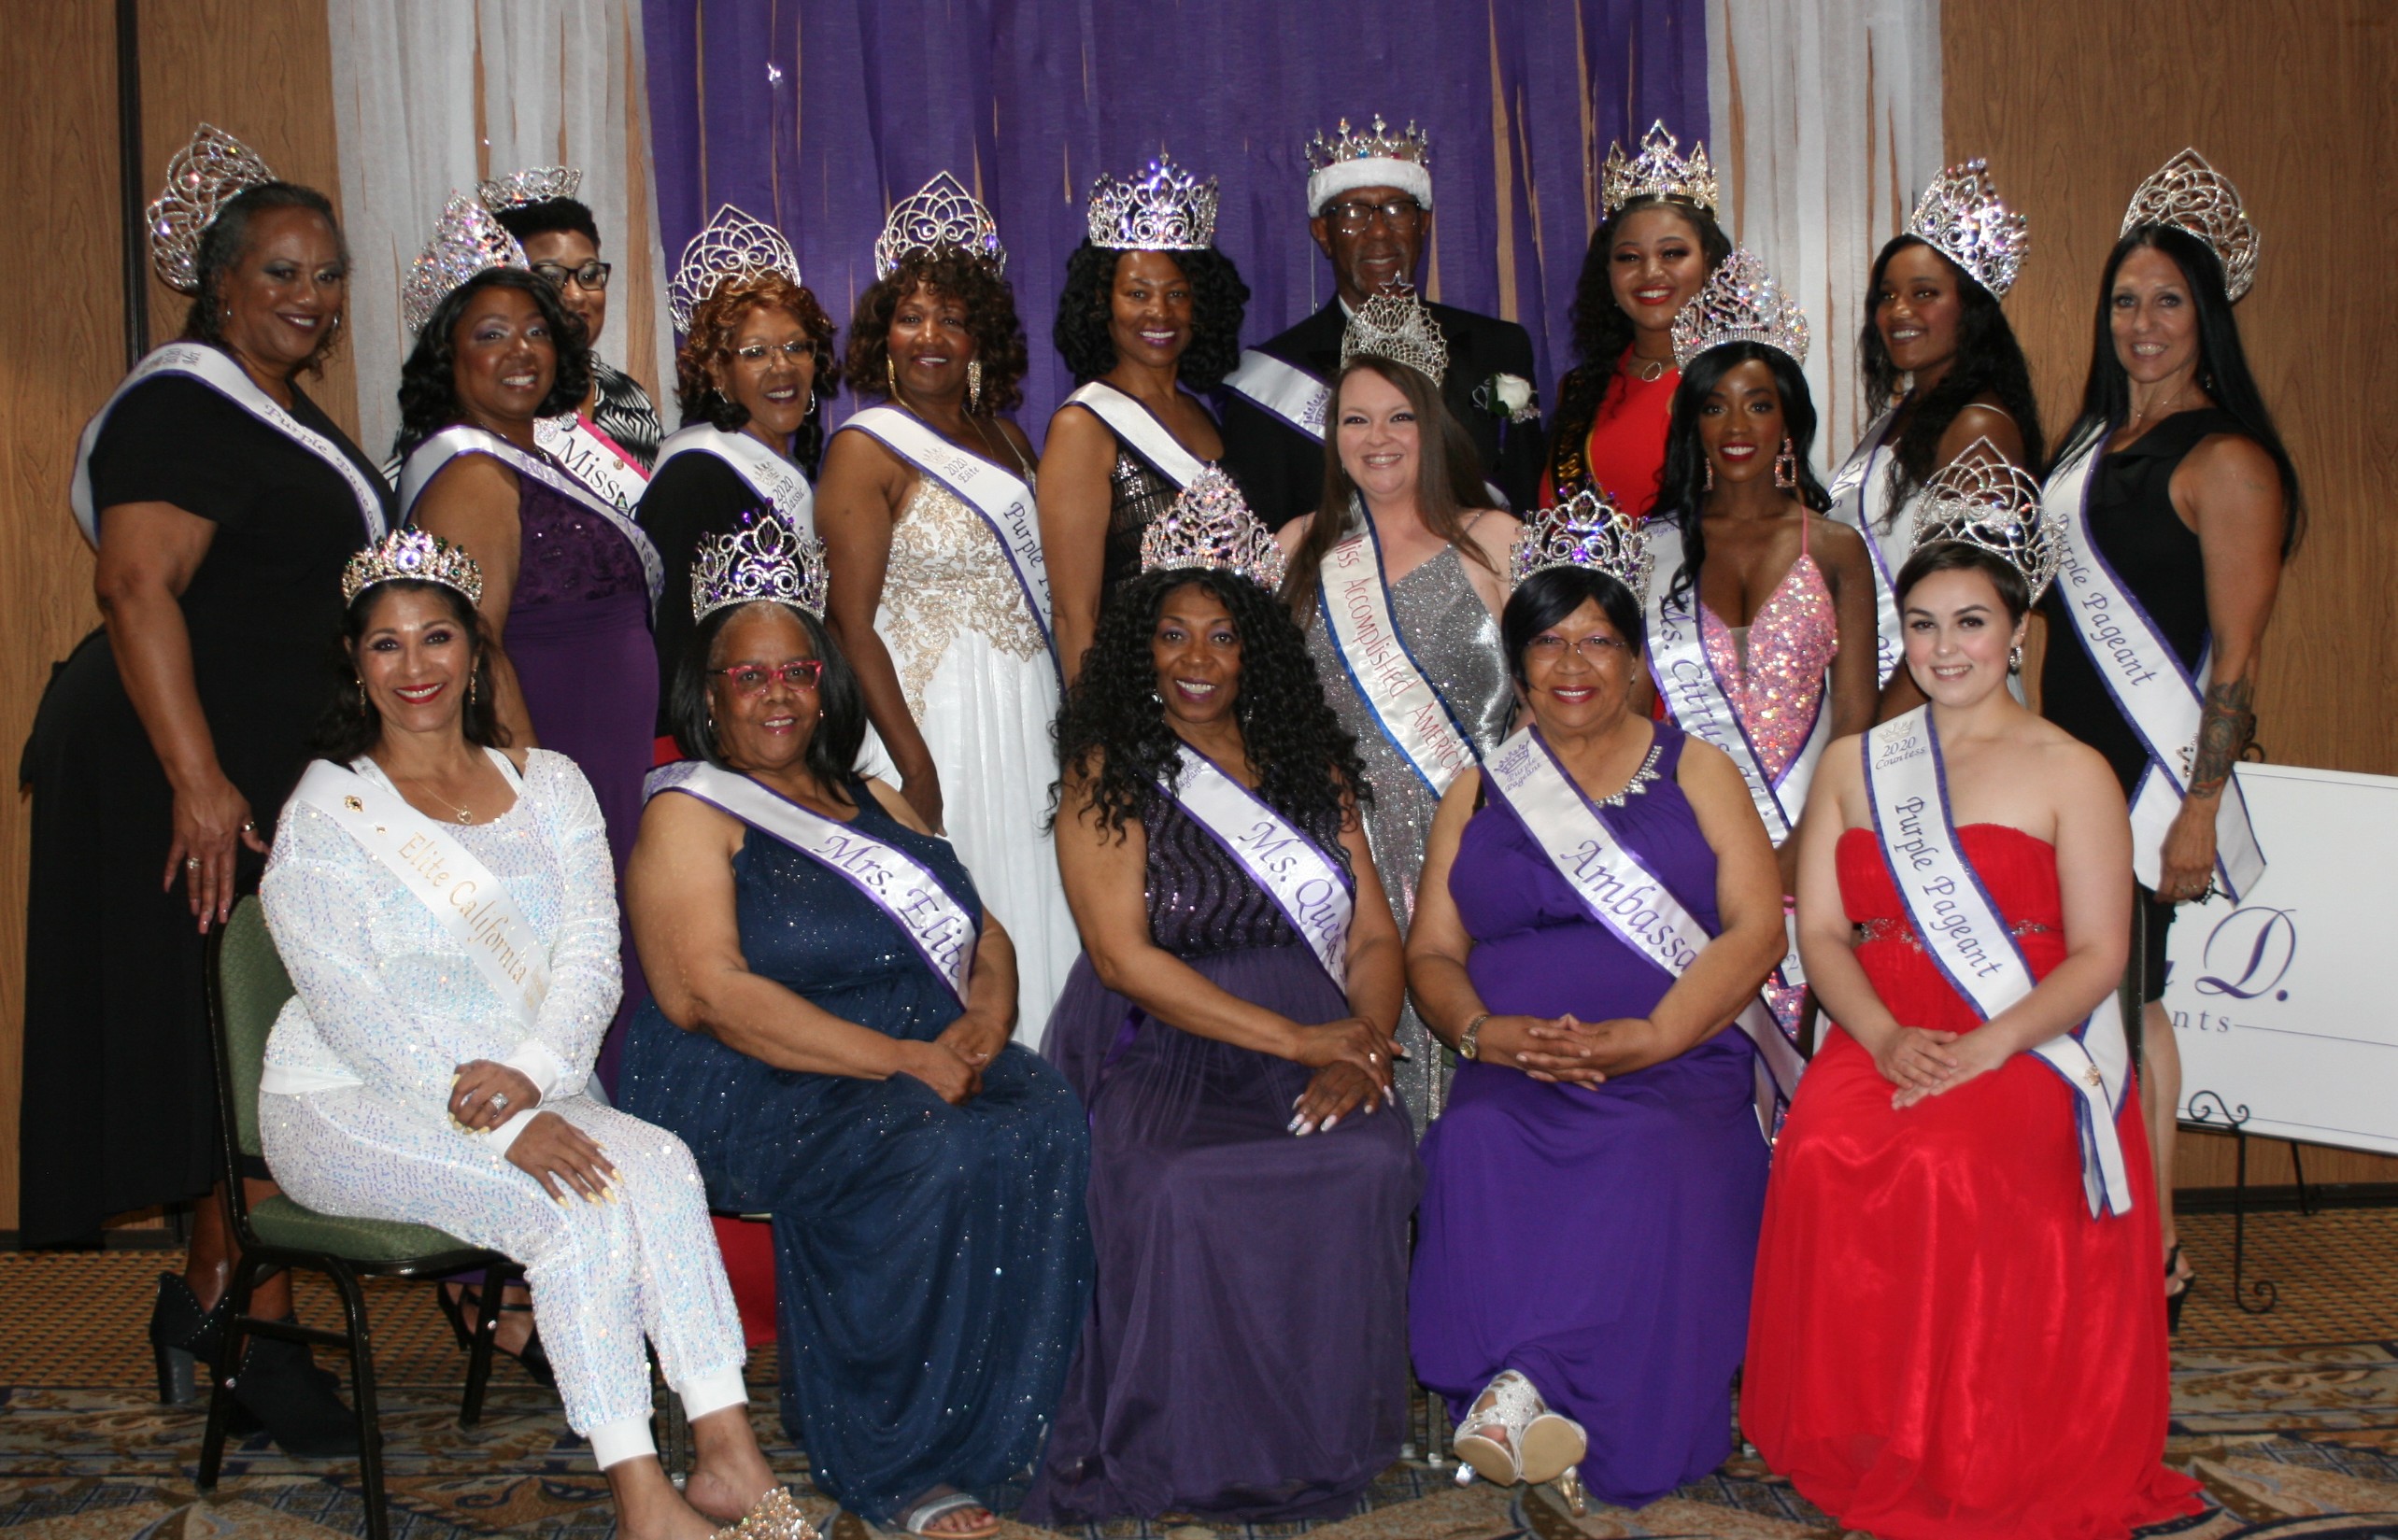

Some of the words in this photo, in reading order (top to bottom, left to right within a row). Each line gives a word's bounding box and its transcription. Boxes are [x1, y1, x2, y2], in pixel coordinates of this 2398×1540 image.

[264, 403, 328, 455] Purple
[336, 457, 377, 536] Pagean
[558, 435, 619, 500] Miss
[944, 458, 968, 477] 2020
[958, 466, 980, 484] Elite
[772, 475, 794, 502] 2020
[781, 487, 804, 516] Classic
[1003, 502, 1044, 568] Purple
[1335, 532, 1363, 569] Miss
[2081, 592, 2157, 686] Pageant
[1875, 746, 1927, 770] Countess
[1881, 736, 1916, 757] 2020
[1175, 765, 1203, 789] ageant
[1504, 762, 1541, 793] Pageant
[1506, 756, 1537, 784] Purple
[812, 835, 894, 896] Mrs.
[1238, 821, 1301, 883] Ms.
[1894, 797, 1939, 872] Purple
[1922, 876, 2003, 978] Pageant
[397, 831, 450, 887] Elite
[448, 881, 527, 985] California
[2194, 906, 2297, 1002] D.
